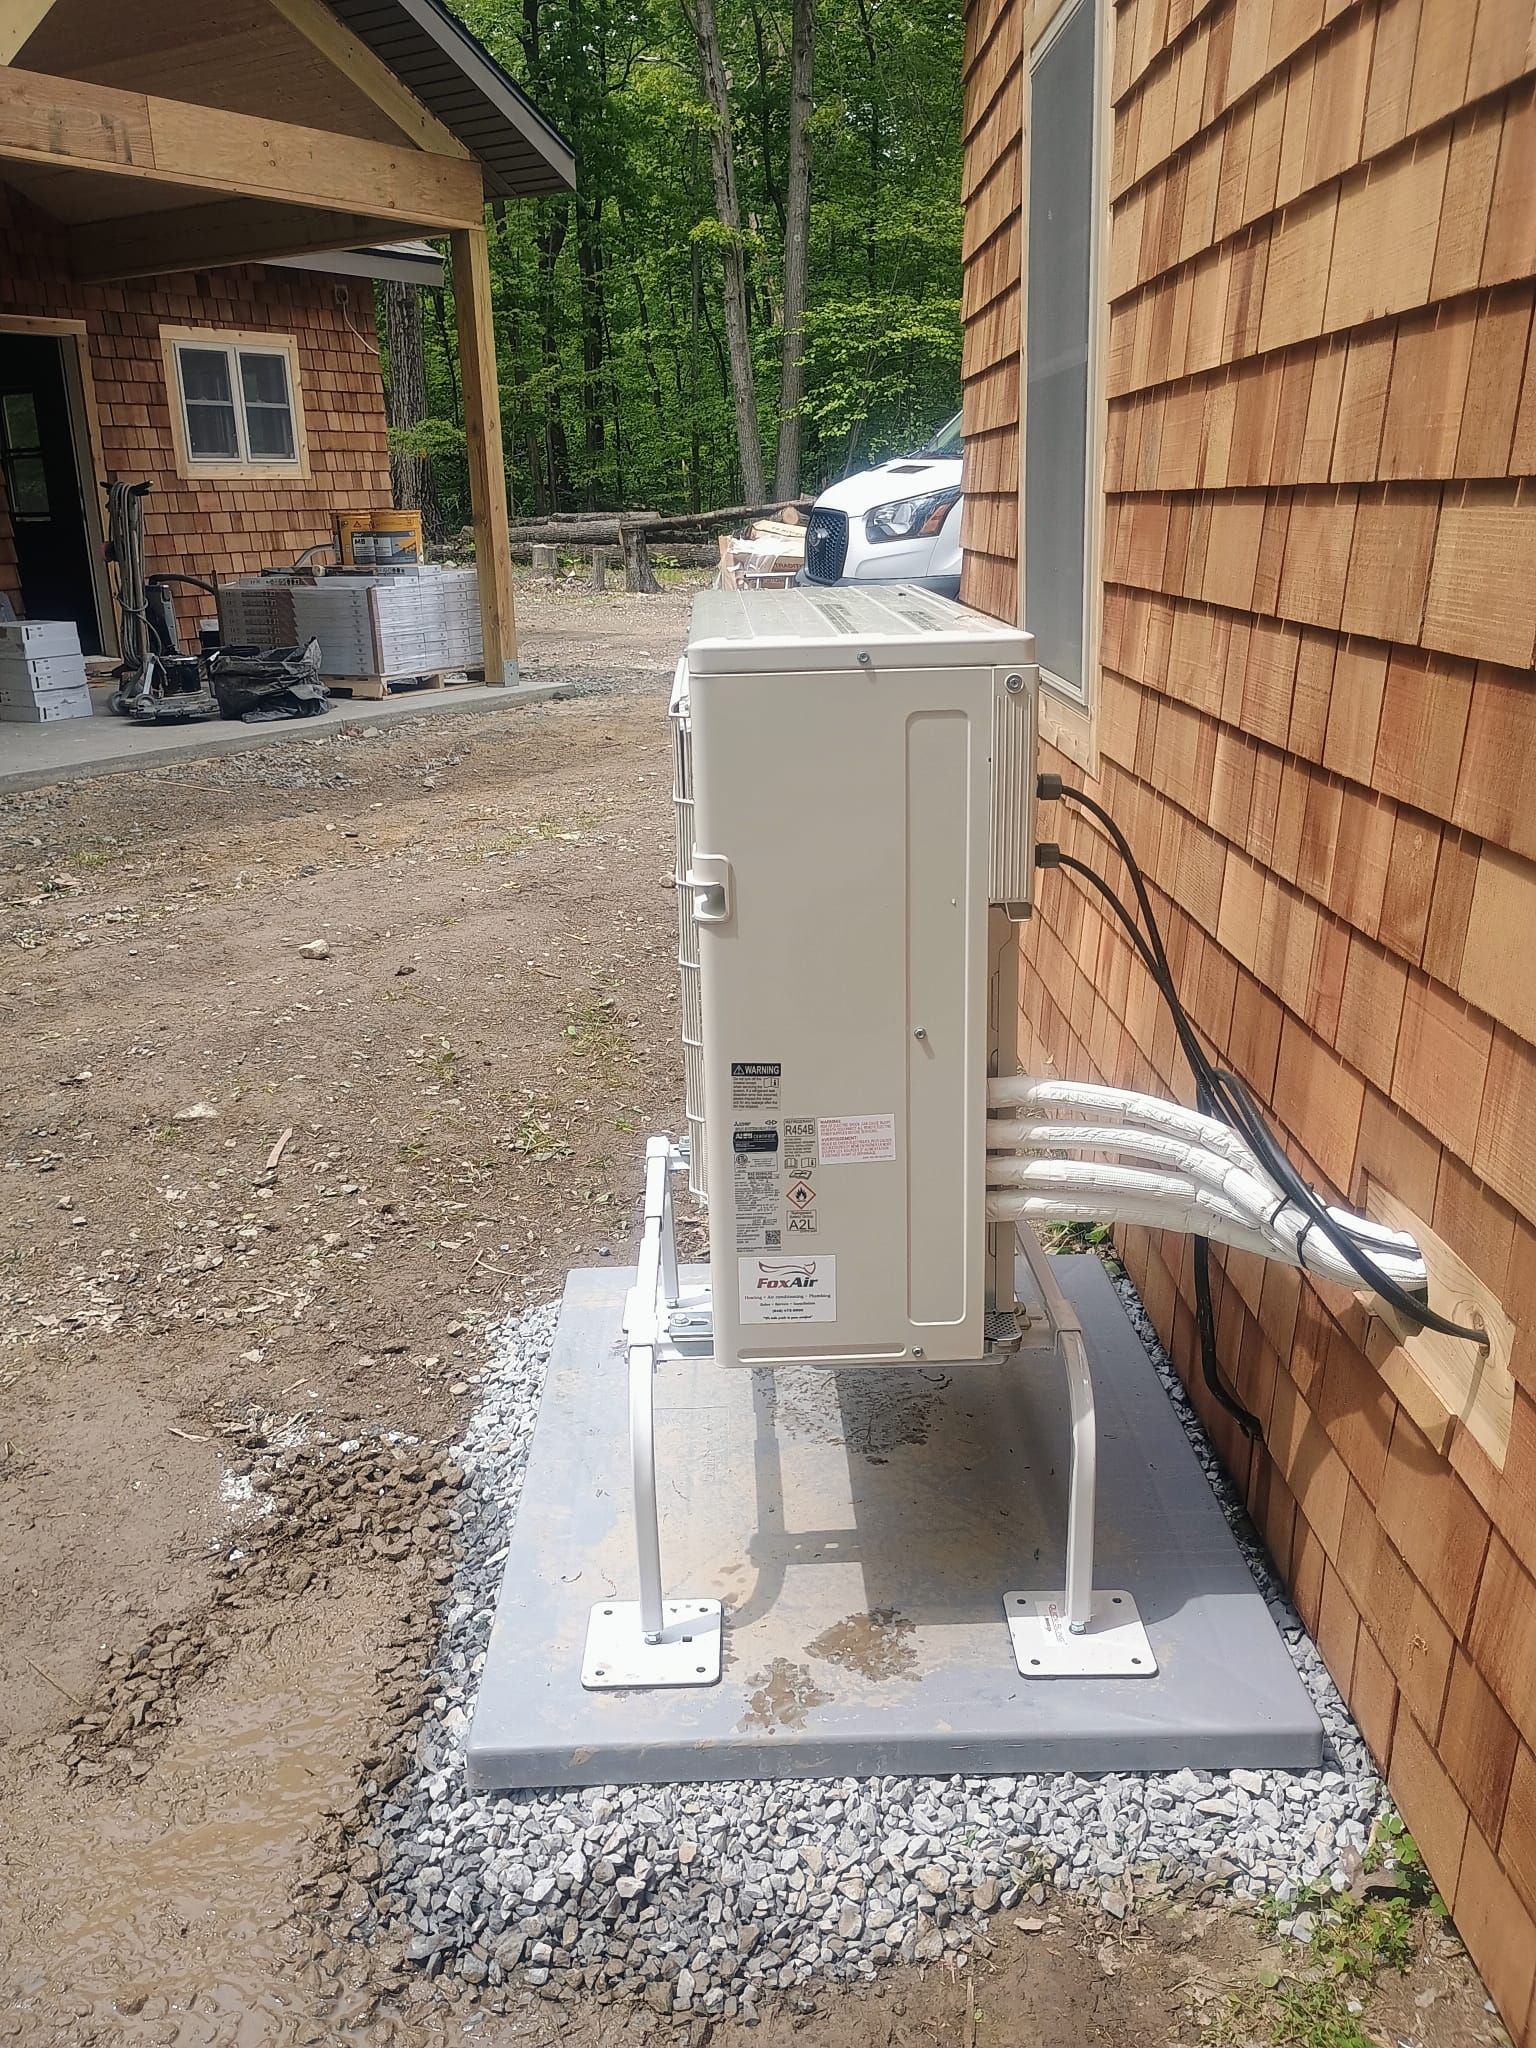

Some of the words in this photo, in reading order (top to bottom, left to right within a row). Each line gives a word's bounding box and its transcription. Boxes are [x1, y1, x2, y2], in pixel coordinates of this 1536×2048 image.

[744, 1065, 780, 1075] WARNING
[785, 1124, 814, 1136] R454B
[789, 1219, 815, 1231] A2L
[757, 1277, 818, 1289] FoxAir
